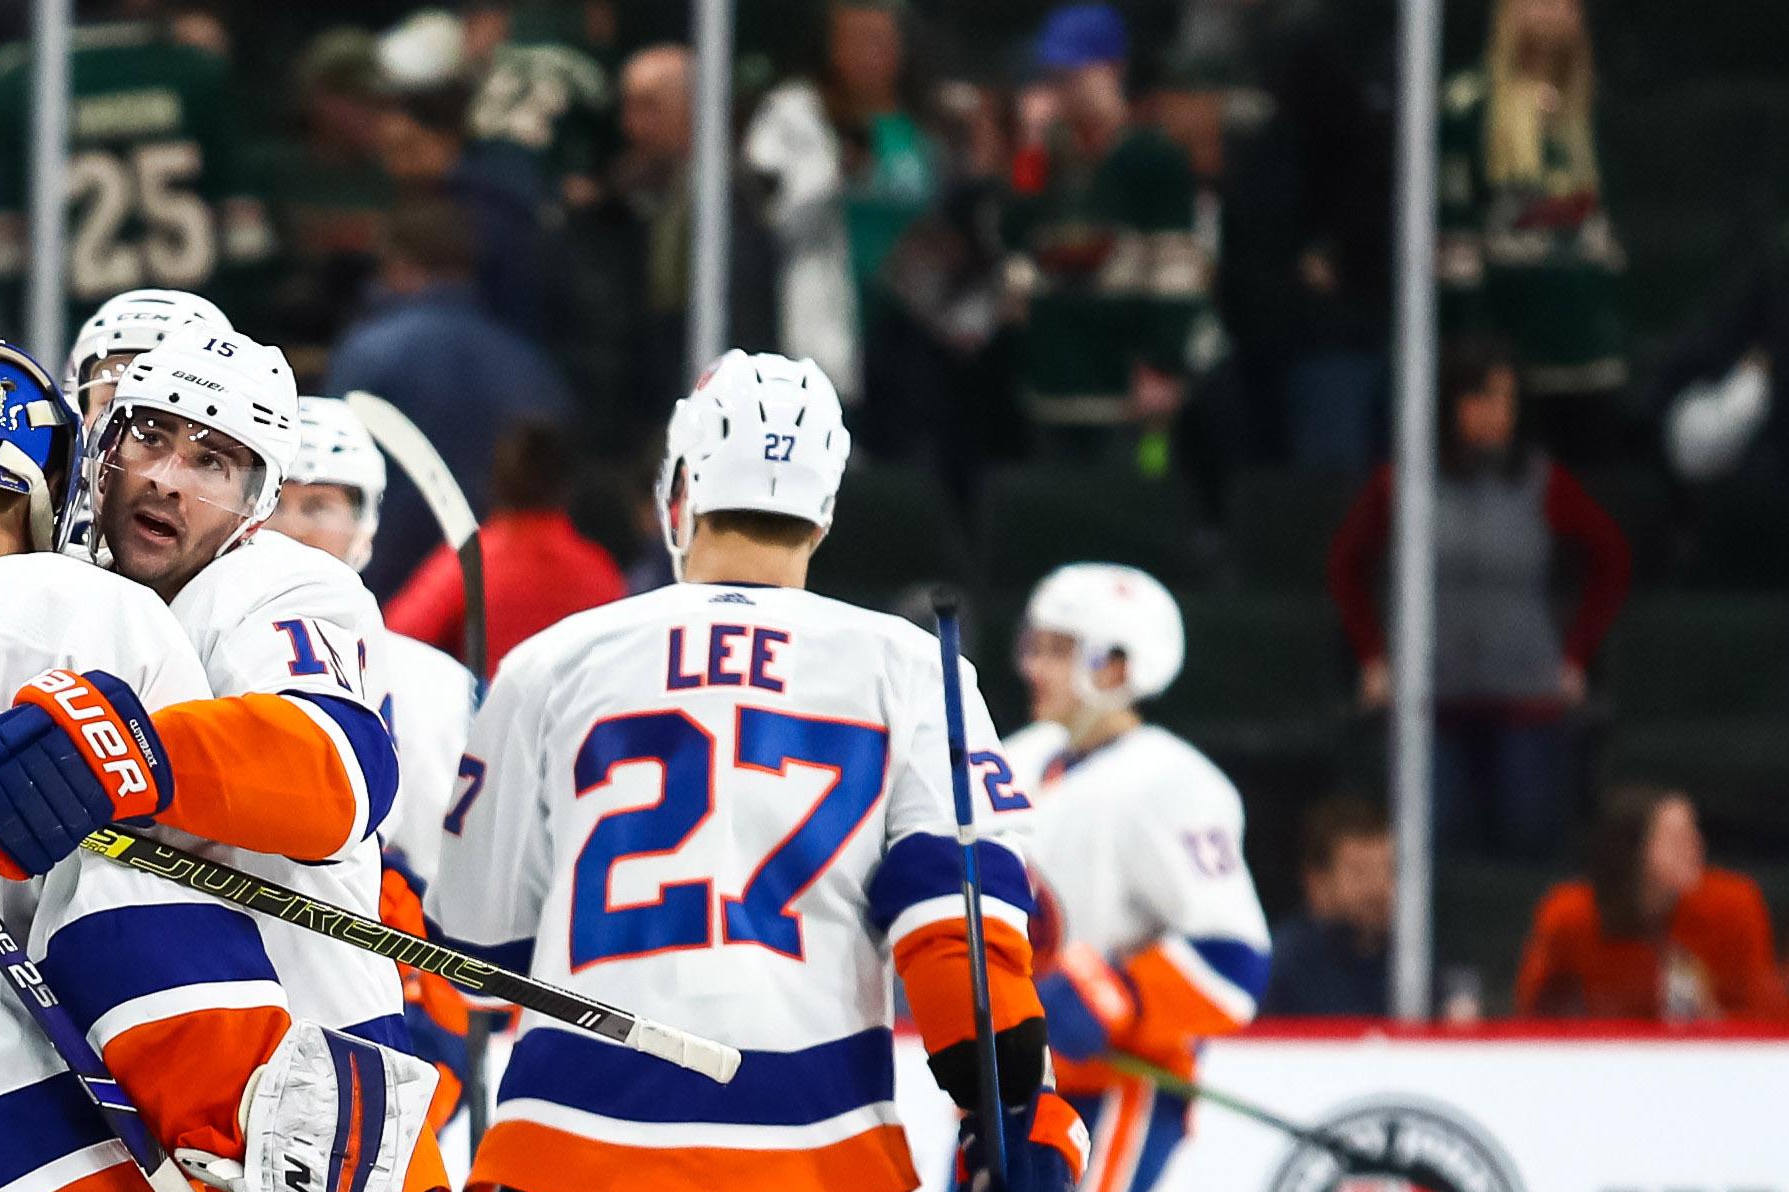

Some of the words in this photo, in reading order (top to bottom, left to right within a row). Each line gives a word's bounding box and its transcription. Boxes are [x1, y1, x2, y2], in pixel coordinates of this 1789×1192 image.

[64, 143, 210, 296] 25
[203, 338, 238, 357] 15
[764, 433, 795, 461] 27
[666, 624, 790, 693] LEE
[27, 669, 148, 797] AUER
[442, 752, 487, 837] 7
[969, 749, 1033, 812] 2
[570, 705, 890, 975] 27
